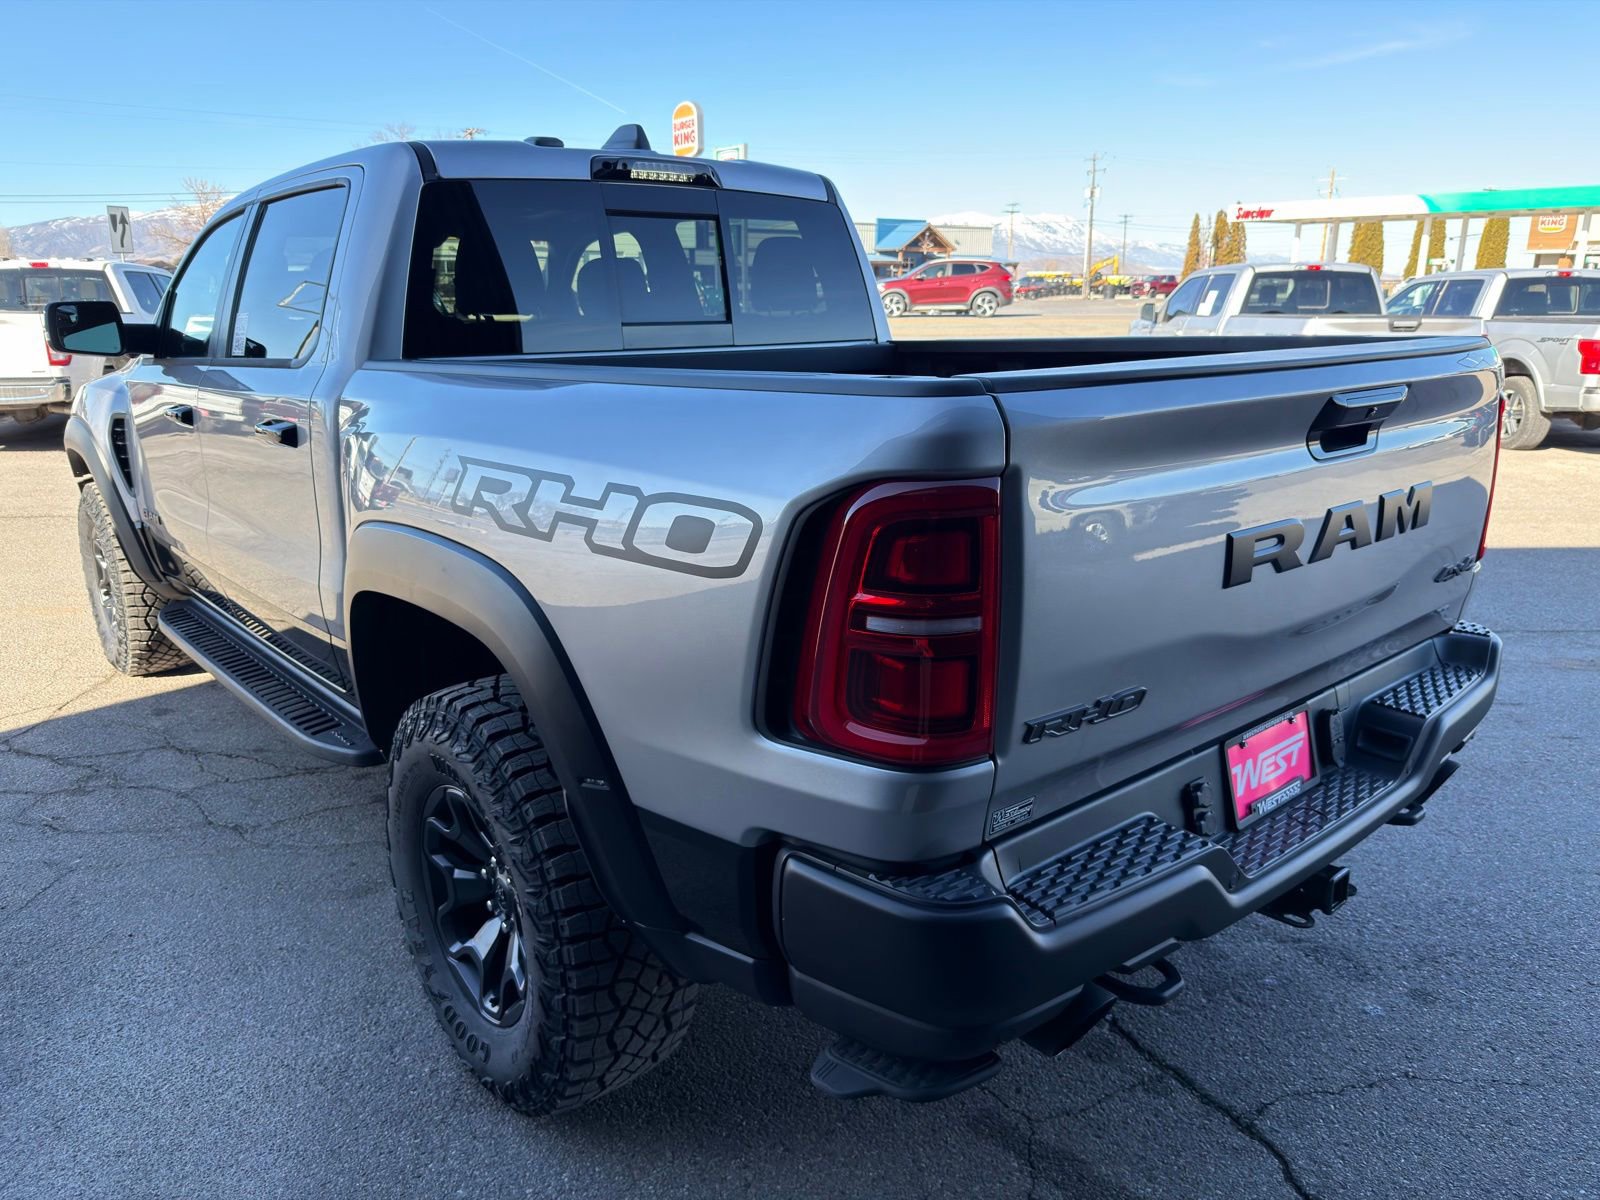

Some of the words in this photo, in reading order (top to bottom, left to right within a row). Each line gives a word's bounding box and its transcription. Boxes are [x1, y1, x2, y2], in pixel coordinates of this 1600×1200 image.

[674, 118, 695, 132] BURGER
[674, 130, 696, 146] KING
[1540, 218, 1565, 226] KING
[450, 455, 763, 579] RHO
[1222, 480, 1433, 589] RAM
[1022, 685, 1147, 744] RHO
[1231, 731, 1305, 797] WEST
